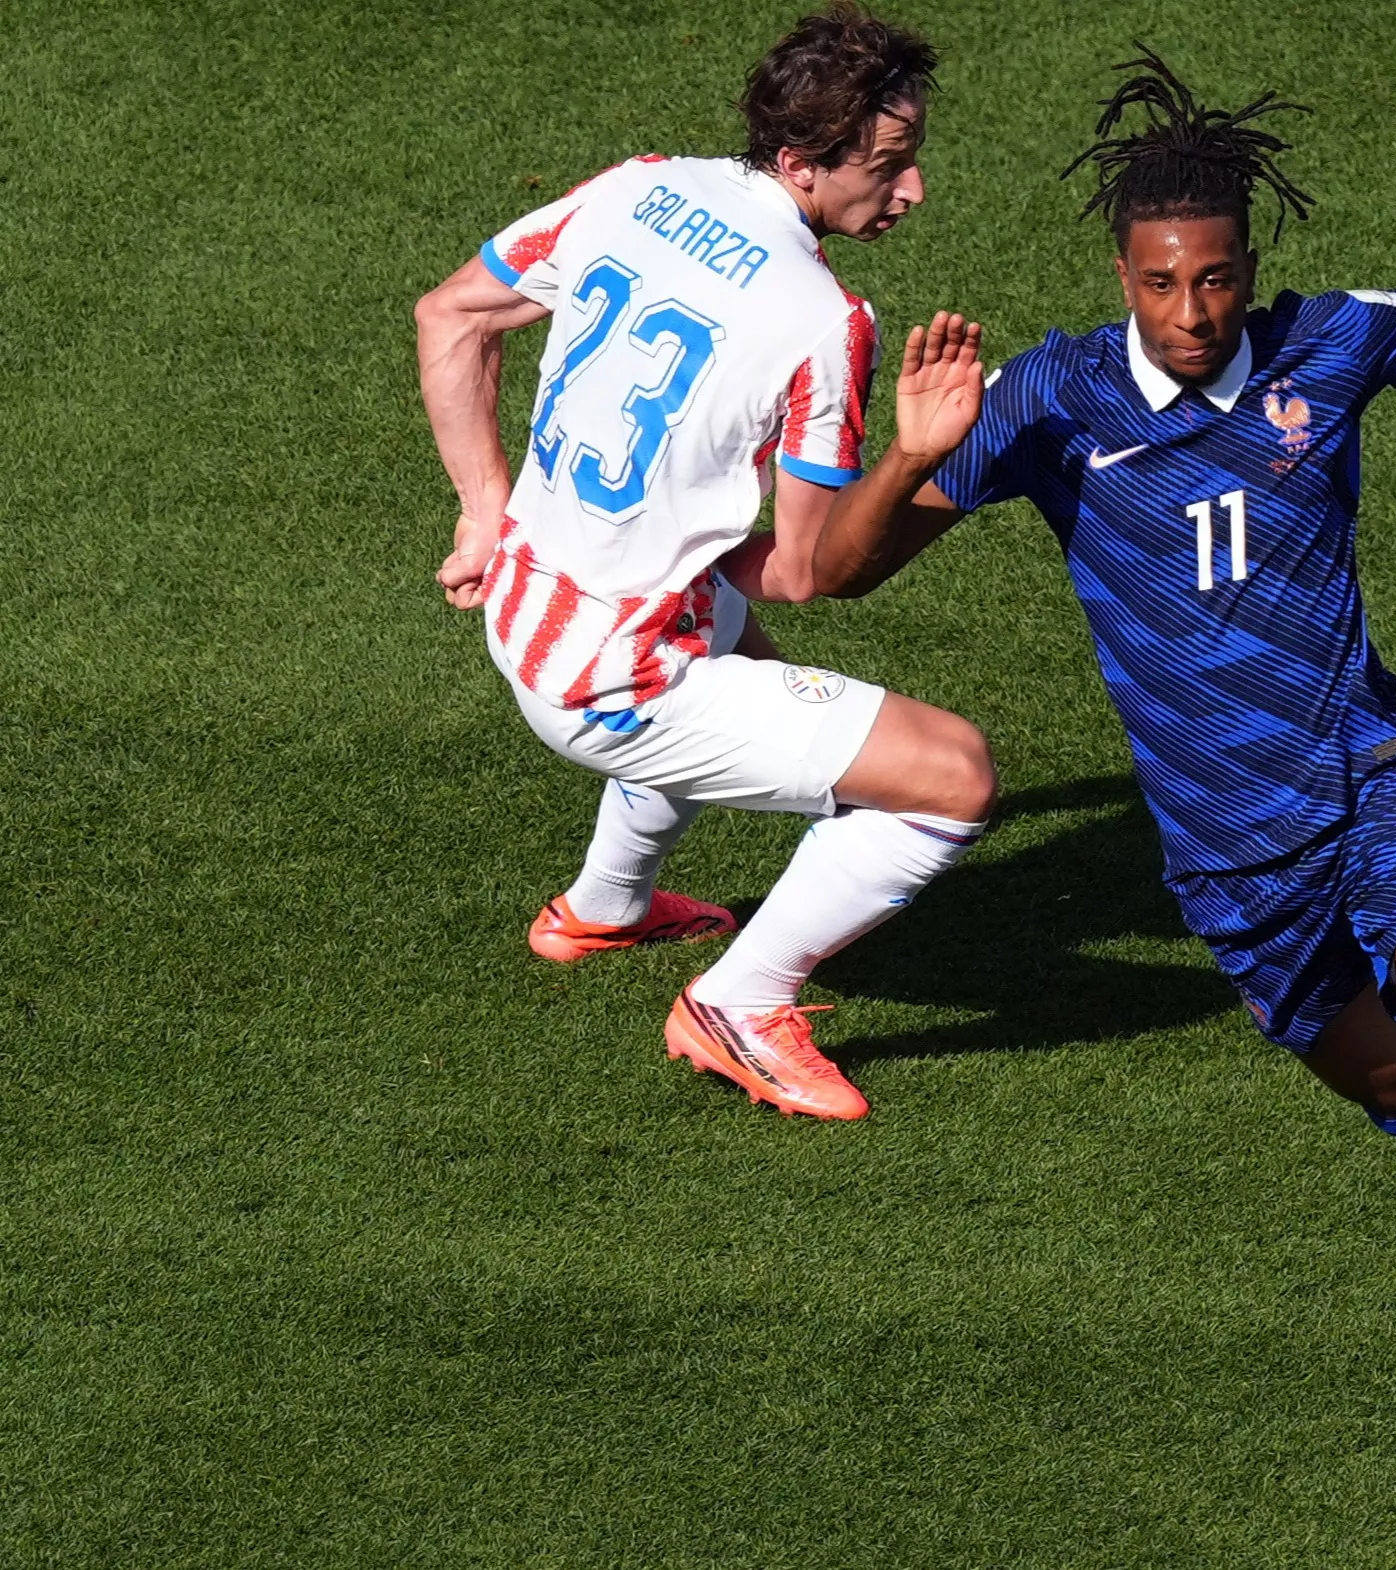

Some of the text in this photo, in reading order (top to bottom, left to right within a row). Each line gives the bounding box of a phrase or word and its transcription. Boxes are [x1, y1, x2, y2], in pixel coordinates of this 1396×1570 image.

[633, 185, 769, 289] GALARZA
[531, 255, 727, 527] 23
[1186, 490, 1247, 591] 11
